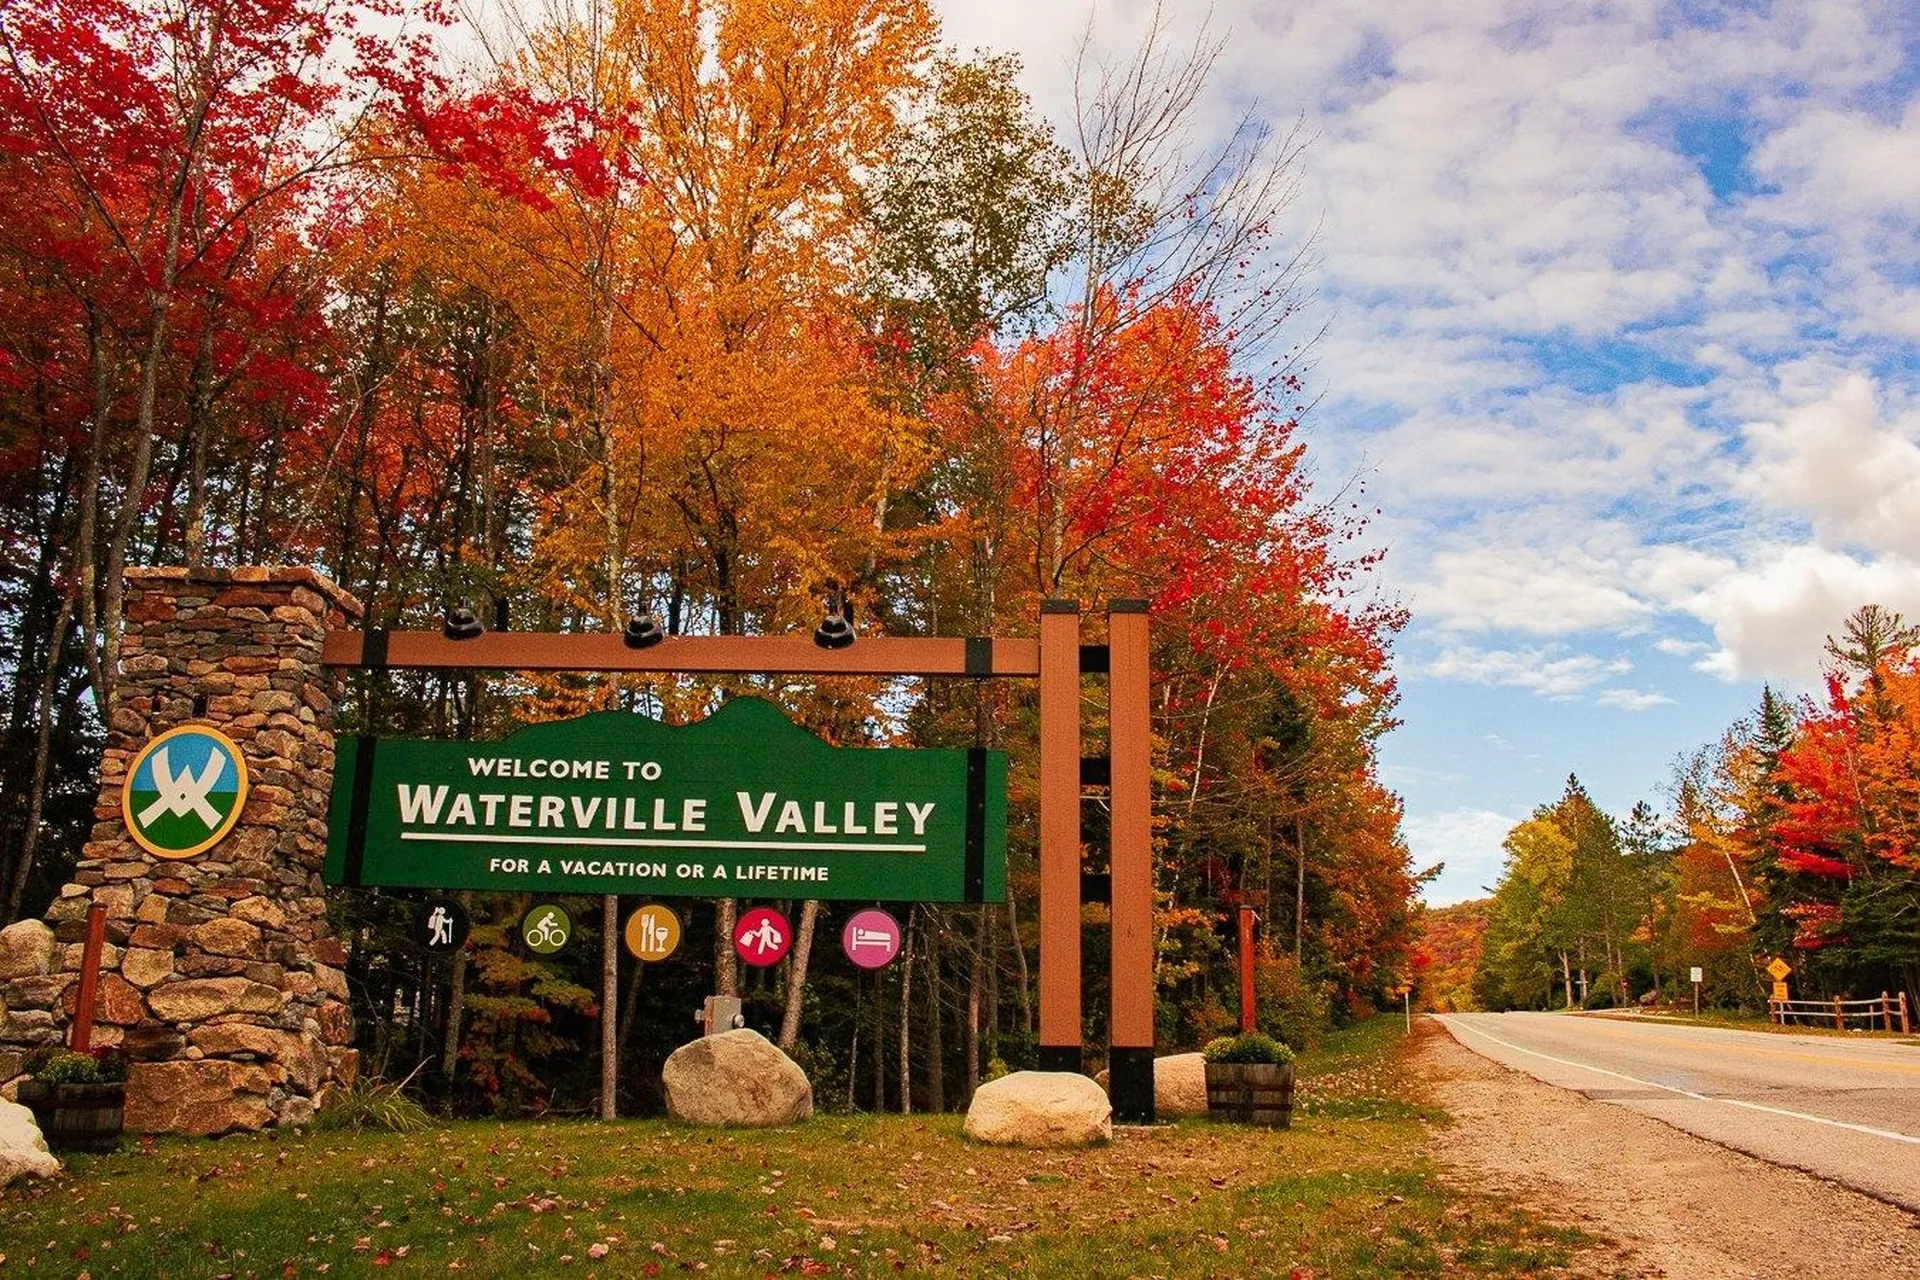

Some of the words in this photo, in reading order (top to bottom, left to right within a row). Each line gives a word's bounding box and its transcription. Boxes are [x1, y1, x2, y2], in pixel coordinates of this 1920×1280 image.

[467, 757, 610, 780] WELCOME
[622, 761, 662, 781] TO
[397, 783, 707, 832] WATERVILLE
[736, 791, 936, 835] VALLEY
[489, 858, 529, 874] FOR
[536, 859, 552, 874] A
[560, 859, 667, 878] VACATION
[675, 863, 705, 879] OR
[712, 864, 728, 879] A
[736, 865, 829, 881] LIFETIME
